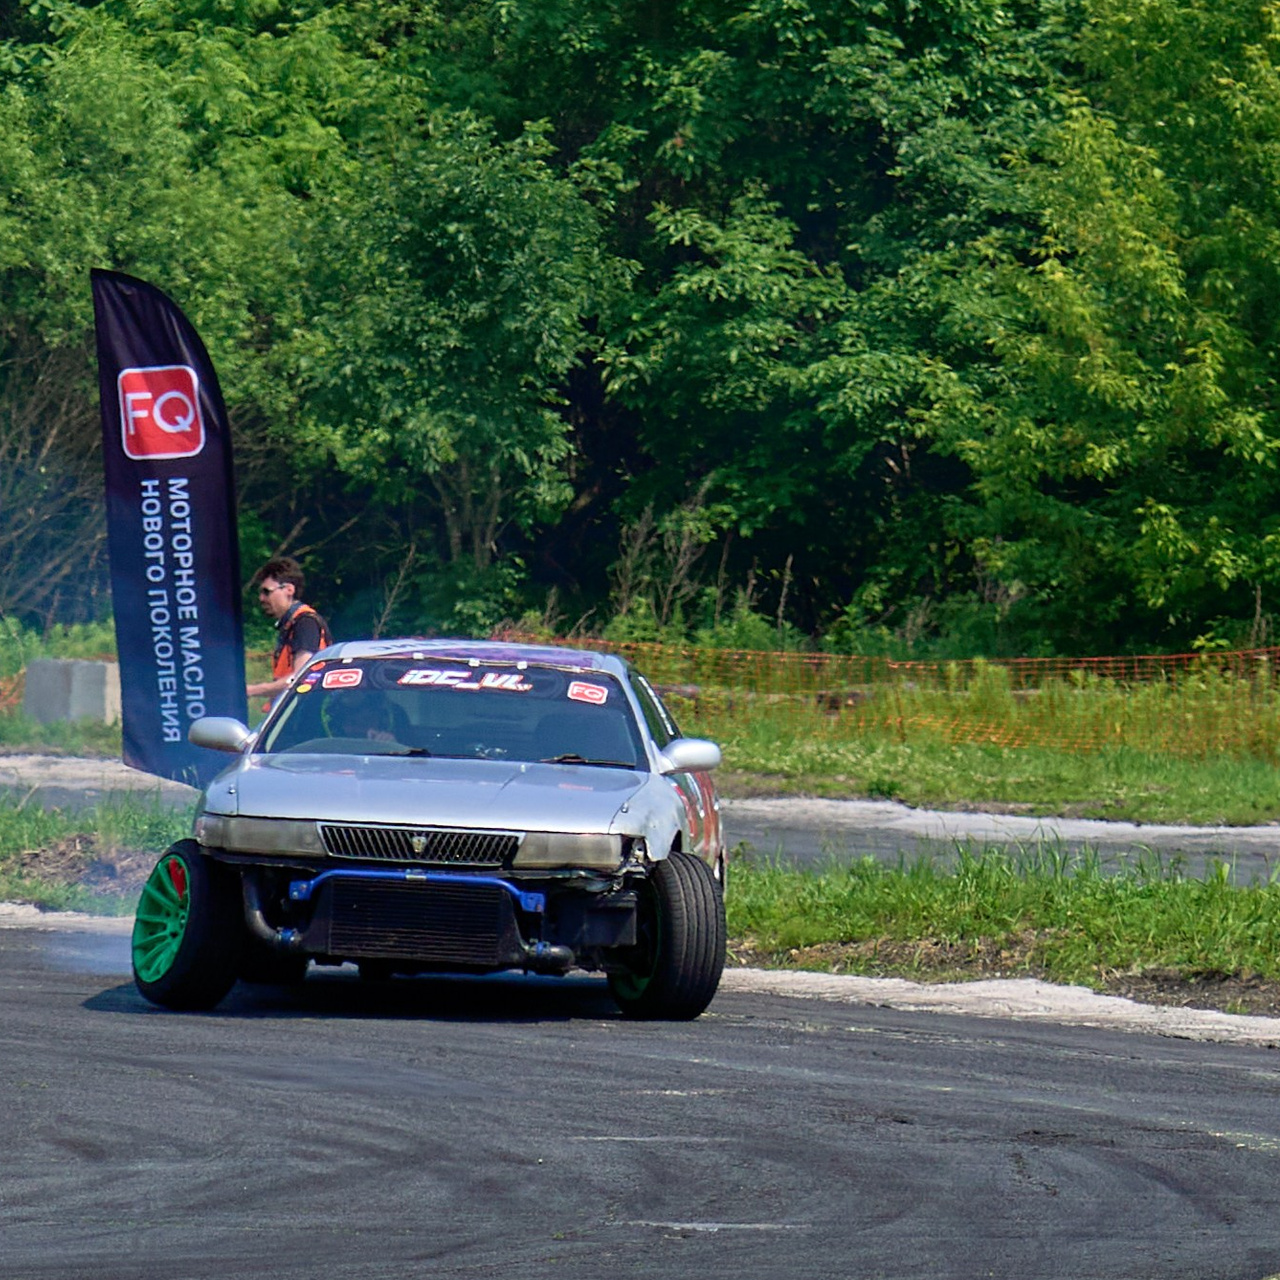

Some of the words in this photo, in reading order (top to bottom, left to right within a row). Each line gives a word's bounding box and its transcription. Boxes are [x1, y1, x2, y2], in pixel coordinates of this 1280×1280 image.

[123, 390, 197, 435] FQ
[140, 478, 166, 582] НОВОГО
[167, 477, 198, 620] МОТОРНОЕ
[147, 589, 181, 743] ПОКОЛЕНИЯ
[179, 625, 206, 720] МАСЛО
[324, 671, 357, 686] FQ
[571, 684, 603, 702] FQ
